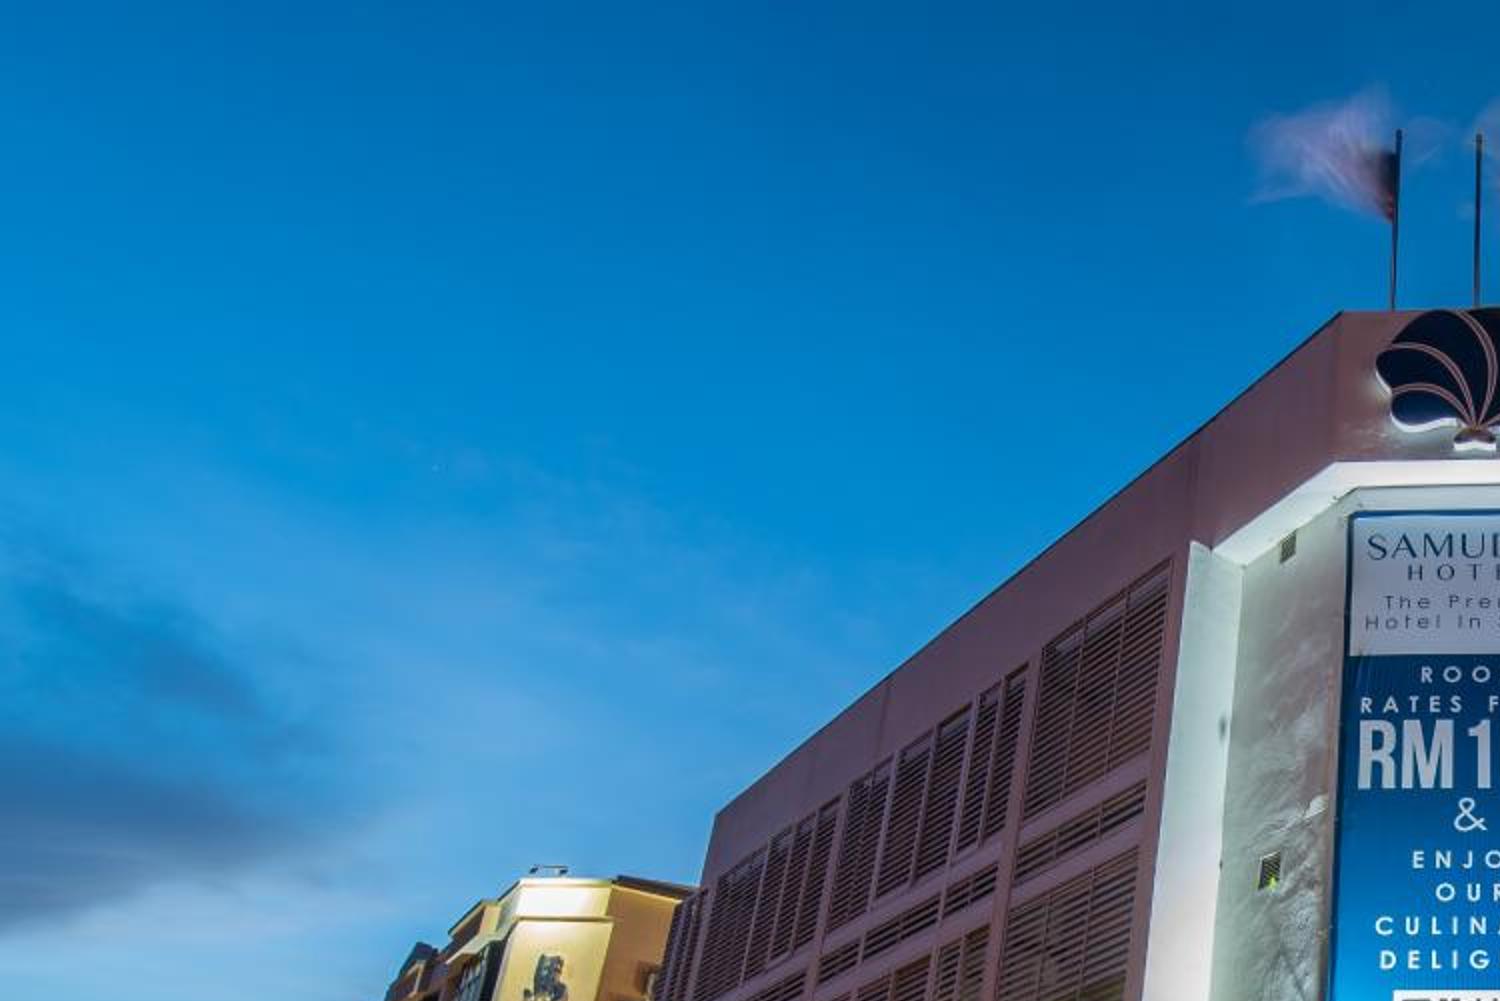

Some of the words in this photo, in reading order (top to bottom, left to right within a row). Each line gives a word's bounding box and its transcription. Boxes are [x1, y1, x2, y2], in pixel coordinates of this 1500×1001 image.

[1384, 595, 1431, 610] The
[1365, 614, 1441, 630] Hotel
[1360, 695, 1463, 713] RATES
[1454, 797, 1487, 832] &
